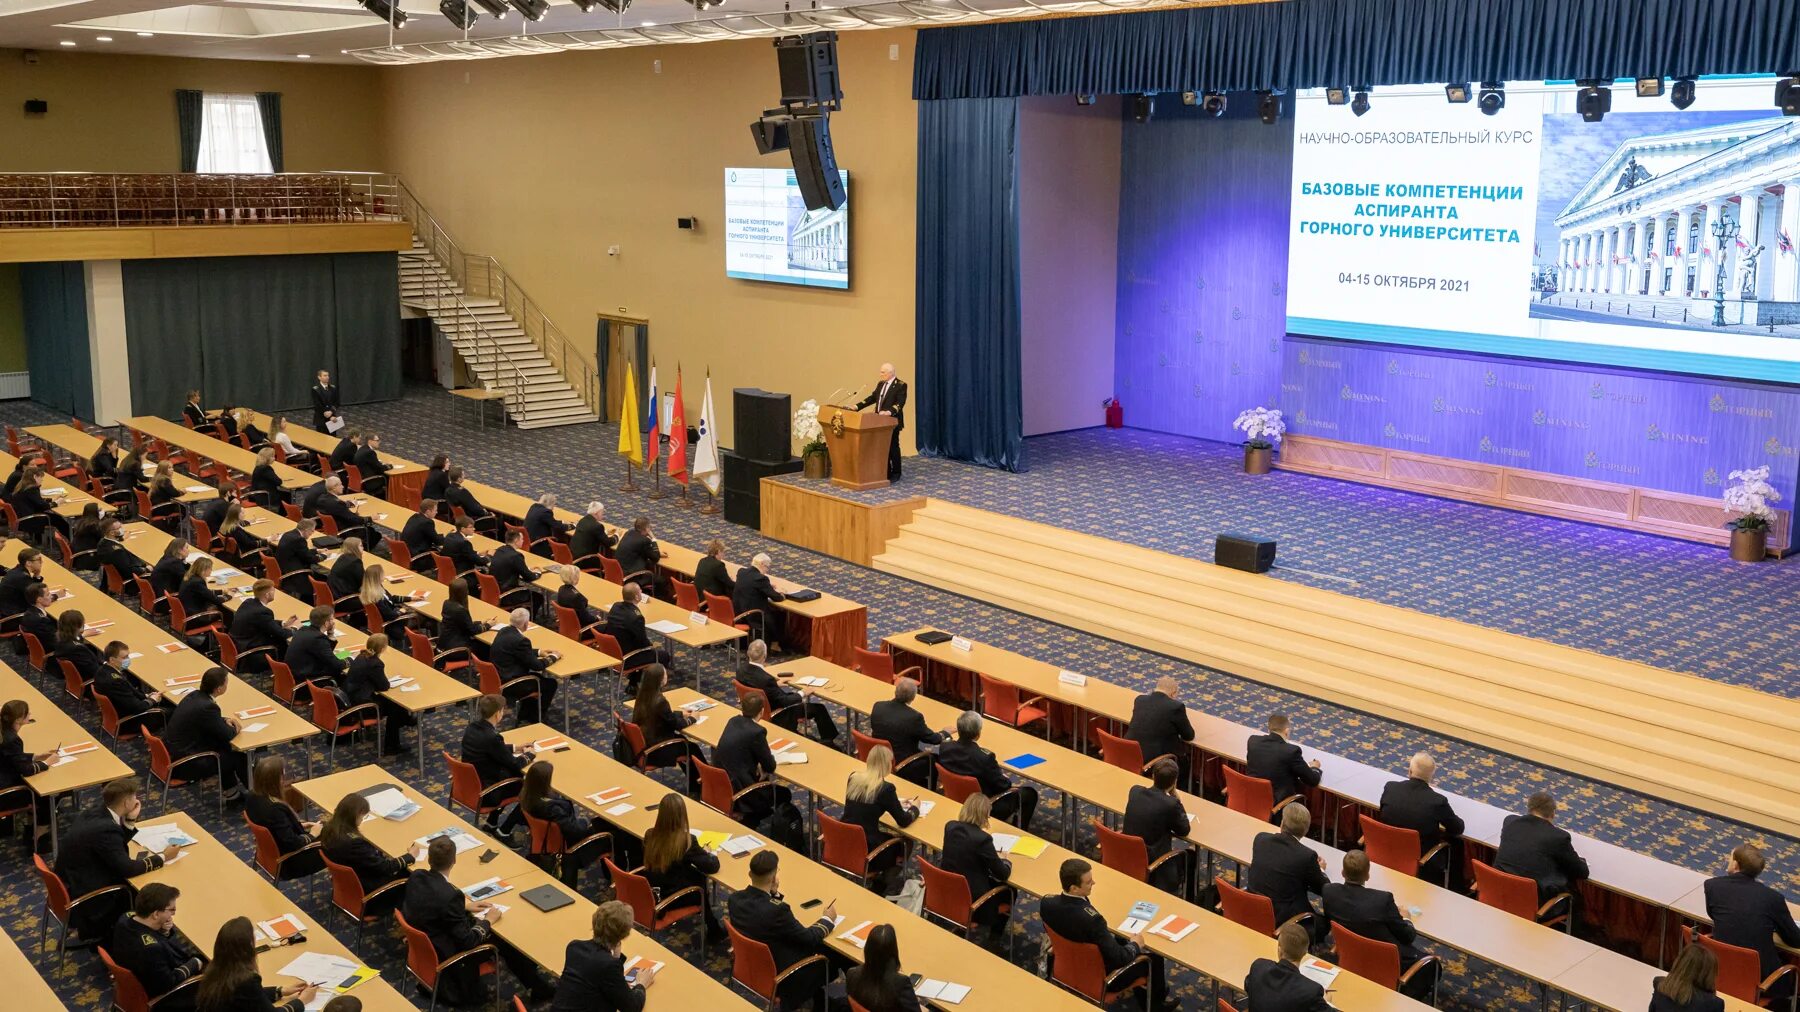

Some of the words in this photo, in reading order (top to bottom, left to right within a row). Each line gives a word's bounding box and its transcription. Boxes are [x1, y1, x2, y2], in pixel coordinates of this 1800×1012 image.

[1299, 129, 1490, 145] НАУЧНО-ОБРАЗОВАТЕЛЬНЫЙ
[1495, 130, 1533, 144] КУРС
[1302, 182, 1380, 197] БАЗОВЫЕ
[1385, 184, 1523, 202] КОМПЕТЕНЦИИ
[1354, 204, 1459, 219] АСПИРАНТА
[1300, 221, 1374, 237] ГОРНОГО
[1380, 224, 1520, 243] УНИВЕРСИТЕТА
[1339, 273, 1370, 286] 04-15
[1374, 275, 1436, 290] ОКТЯБРЯ
[1440, 279, 1469, 292] 2021
